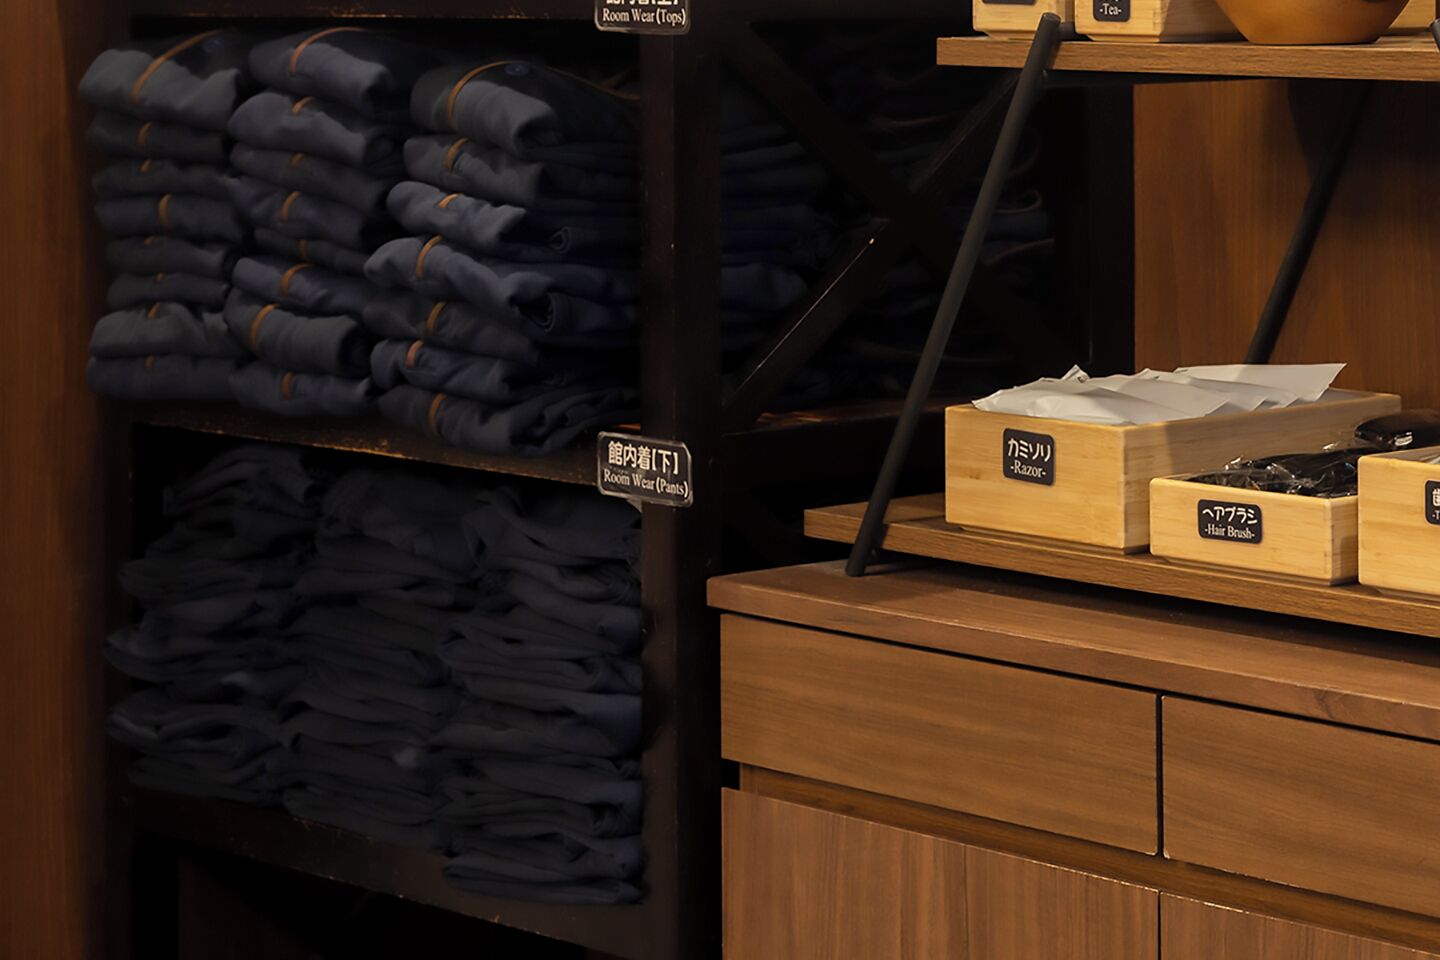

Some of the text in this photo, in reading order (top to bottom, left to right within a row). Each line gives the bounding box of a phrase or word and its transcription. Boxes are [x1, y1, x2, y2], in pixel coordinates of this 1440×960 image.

[602, 8, 629, 22] Room
[631, 8, 655, 22] Wear
[1008, 438, 1051, 462] カミソリ
[1010, 460, 1046, 478] -Razor-
[603, 469, 630, 486] Room
[631, 473, 655, 490] Wear
[1202, 506, 1258, 524] ヘアブラシ
